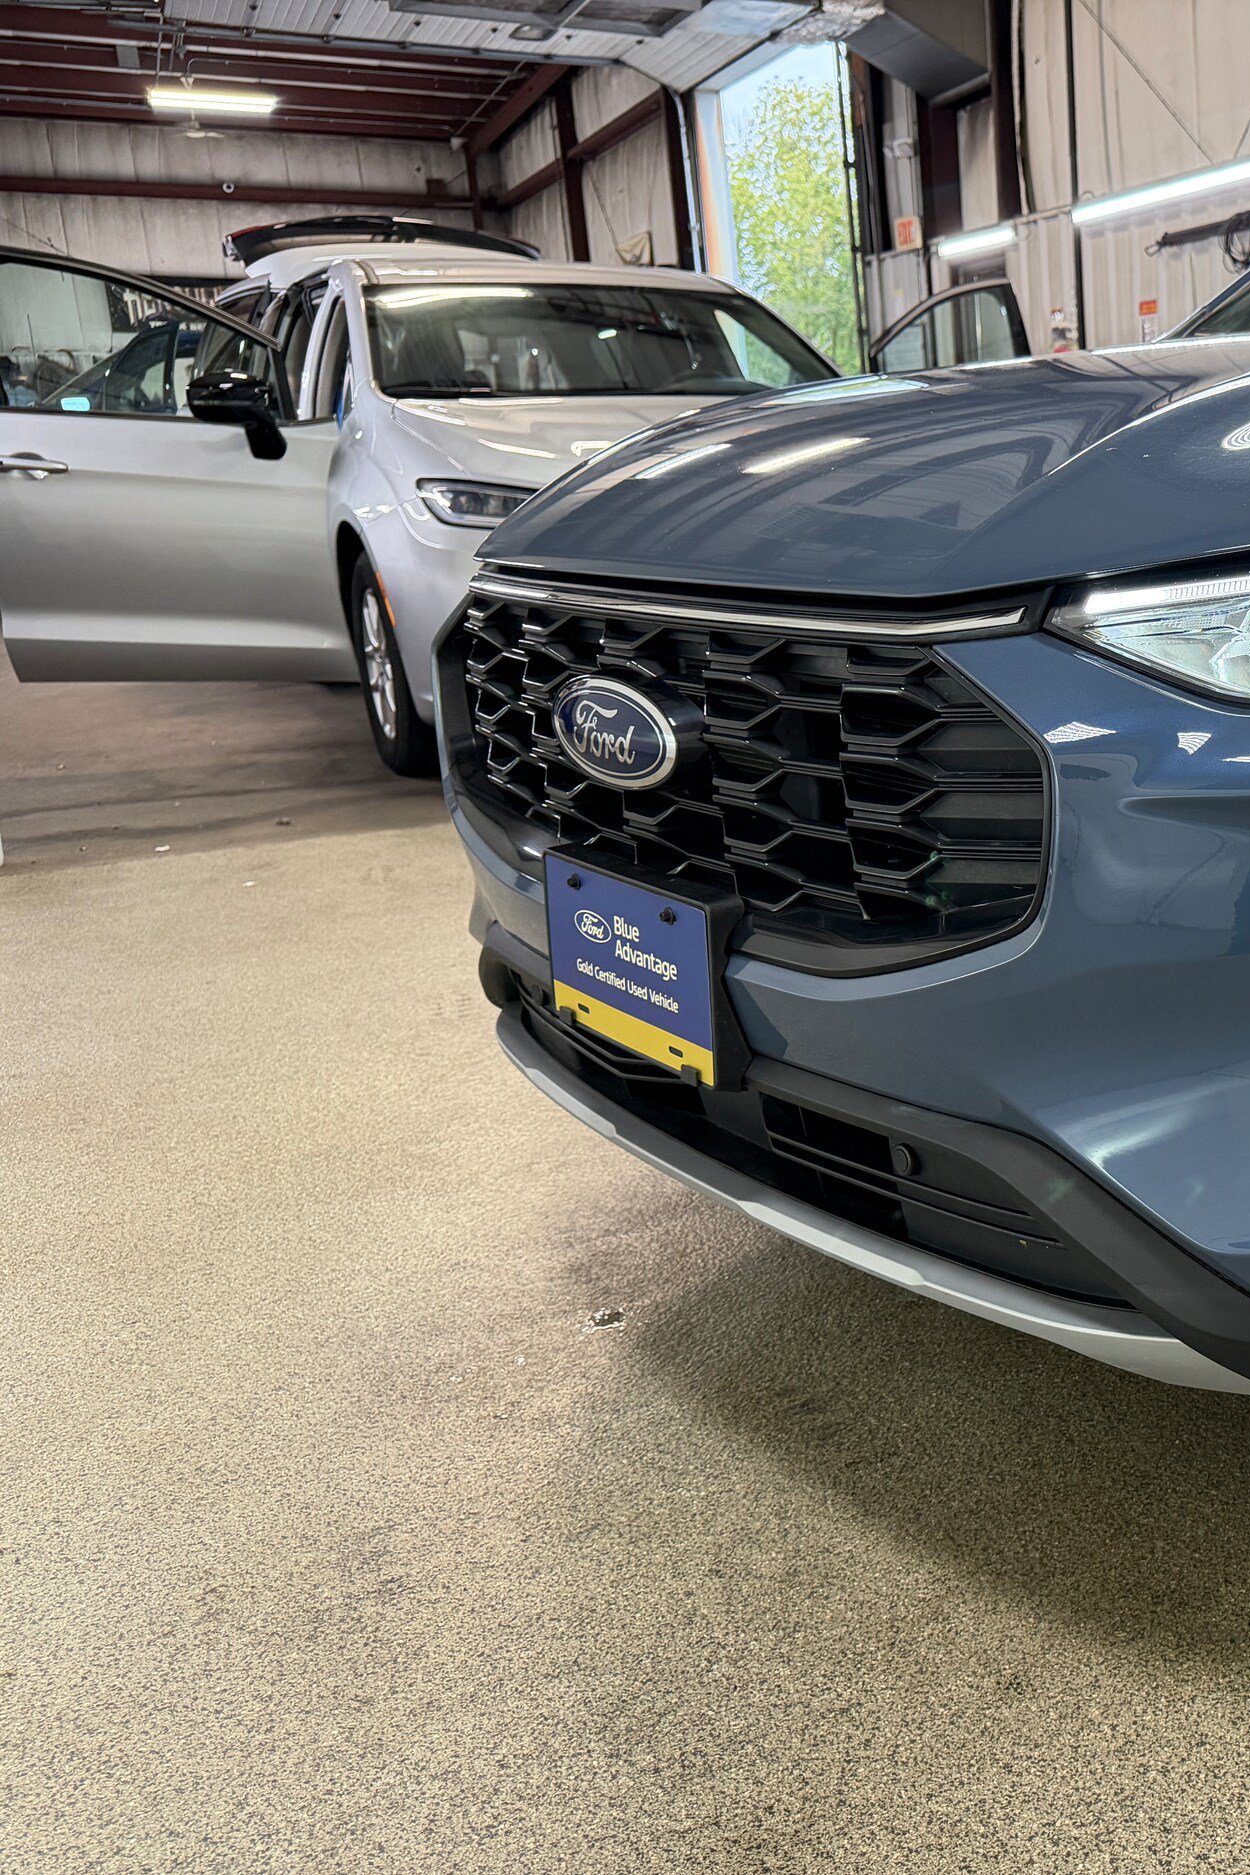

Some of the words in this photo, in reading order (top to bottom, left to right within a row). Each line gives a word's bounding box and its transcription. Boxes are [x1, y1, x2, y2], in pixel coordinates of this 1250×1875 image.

[573, 700, 635, 765] Ford
[581, 913, 605, 939] Ford
[613, 915, 640, 942] Blue
[615, 939, 678, 981] Advantage
[576, 958, 593, 976] Gold
[594, 966, 626, 991] Certified
[627, 979, 648, 1000] Used
[649, 988, 679, 1013] Vehicle
